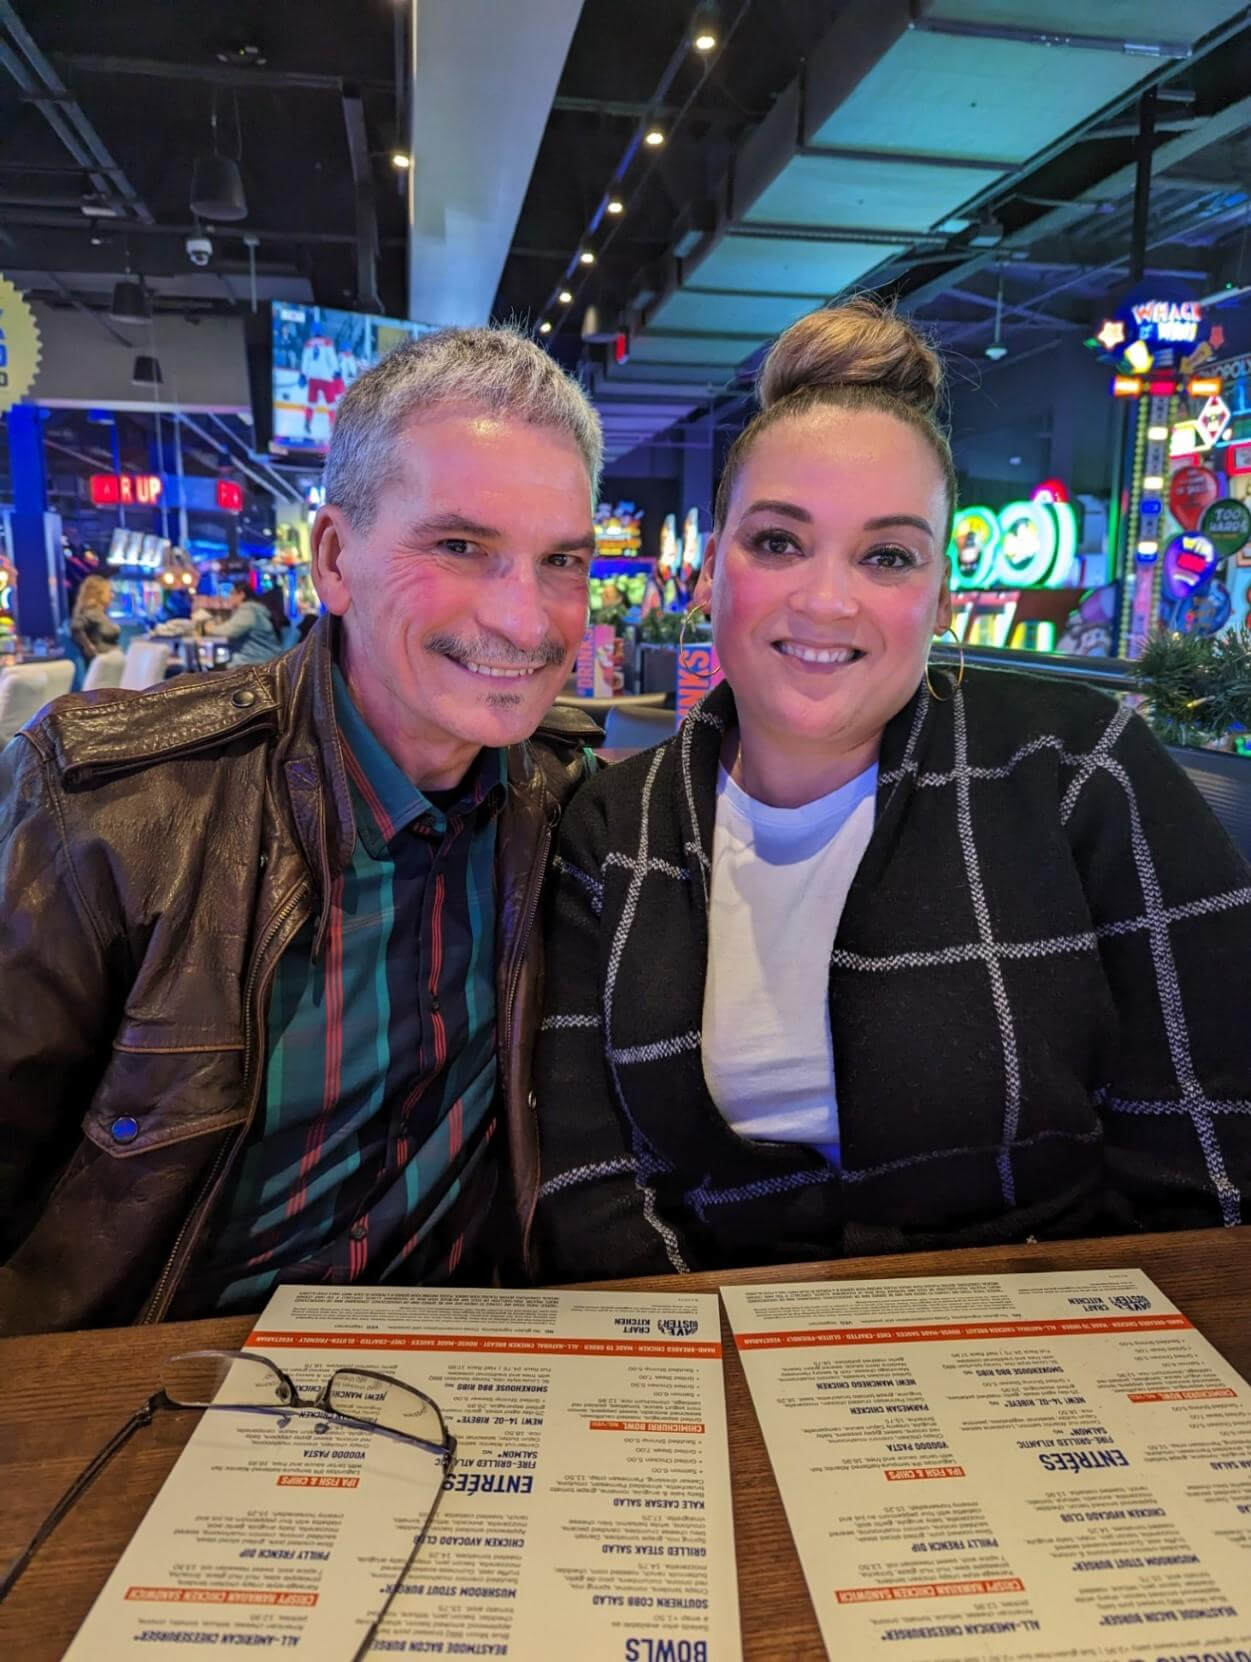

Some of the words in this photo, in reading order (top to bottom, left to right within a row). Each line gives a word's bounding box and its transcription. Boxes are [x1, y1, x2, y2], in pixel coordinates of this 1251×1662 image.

[614, 1318, 650, 1327] KITCHEN
[623, 1326, 650, 1334] CRAFT
[816, 1382, 850, 1390] CHICKEN
[851, 1380, 894, 1389] MANCHEGO
[895, 1378, 917, 1386] NEW!
[496, 1384, 548, 1392] SMOKEHOUSE
[849, 1406, 885, 1414] CHICKEN
[886, 1403, 929, 1412] PARMESAN
[886, 1443, 913, 1452] PASTA
[915, 1441, 948, 1450] VOODOO
[1016, 1440, 1055, 1449] ATLANTIC
[303, 1450, 329, 1458] PASTA
[331, 1450, 366, 1459] VOODOO
[476, 1459, 536, 1469] FIRE-GRILLED
[1038, 1449, 1129, 1474] ENTRÉES
[320, 1477, 339, 1487] FISH
[441, 1473, 534, 1496] ENTRÉES
[613, 1498, 641, 1507] SALAD
[644, 1499, 679, 1508] CAESAR
[682, 1500, 705, 1509] KALE
[439, 1536, 482, 1546] AVOCADO
[485, 1537, 525, 1548] CHICKEN
[601, 1544, 632, 1553] SALAD
[635, 1545, 664, 1555] STEAK
[667, 1546, 706, 1557] GRILLED
[239, 1549, 256, 1558] DIP
[258, 1550, 295, 1559] FRENCH
[297, 1551, 330, 1561] PHILLY
[427, 1586, 457, 1596] STOUT
[460, 1587, 517, 1598] MUSHROOM
[592, 1595, 624, 1605] SALAD
[627, 1596, 653, 1607] COBB
[656, 1597, 709, 1609] SOUTHERN
[221, 1633, 300, 1648] ALL-AMERICAN
[409, 1641, 444, 1653] BACON
[625, 1638, 708, 1662] BOWLS
